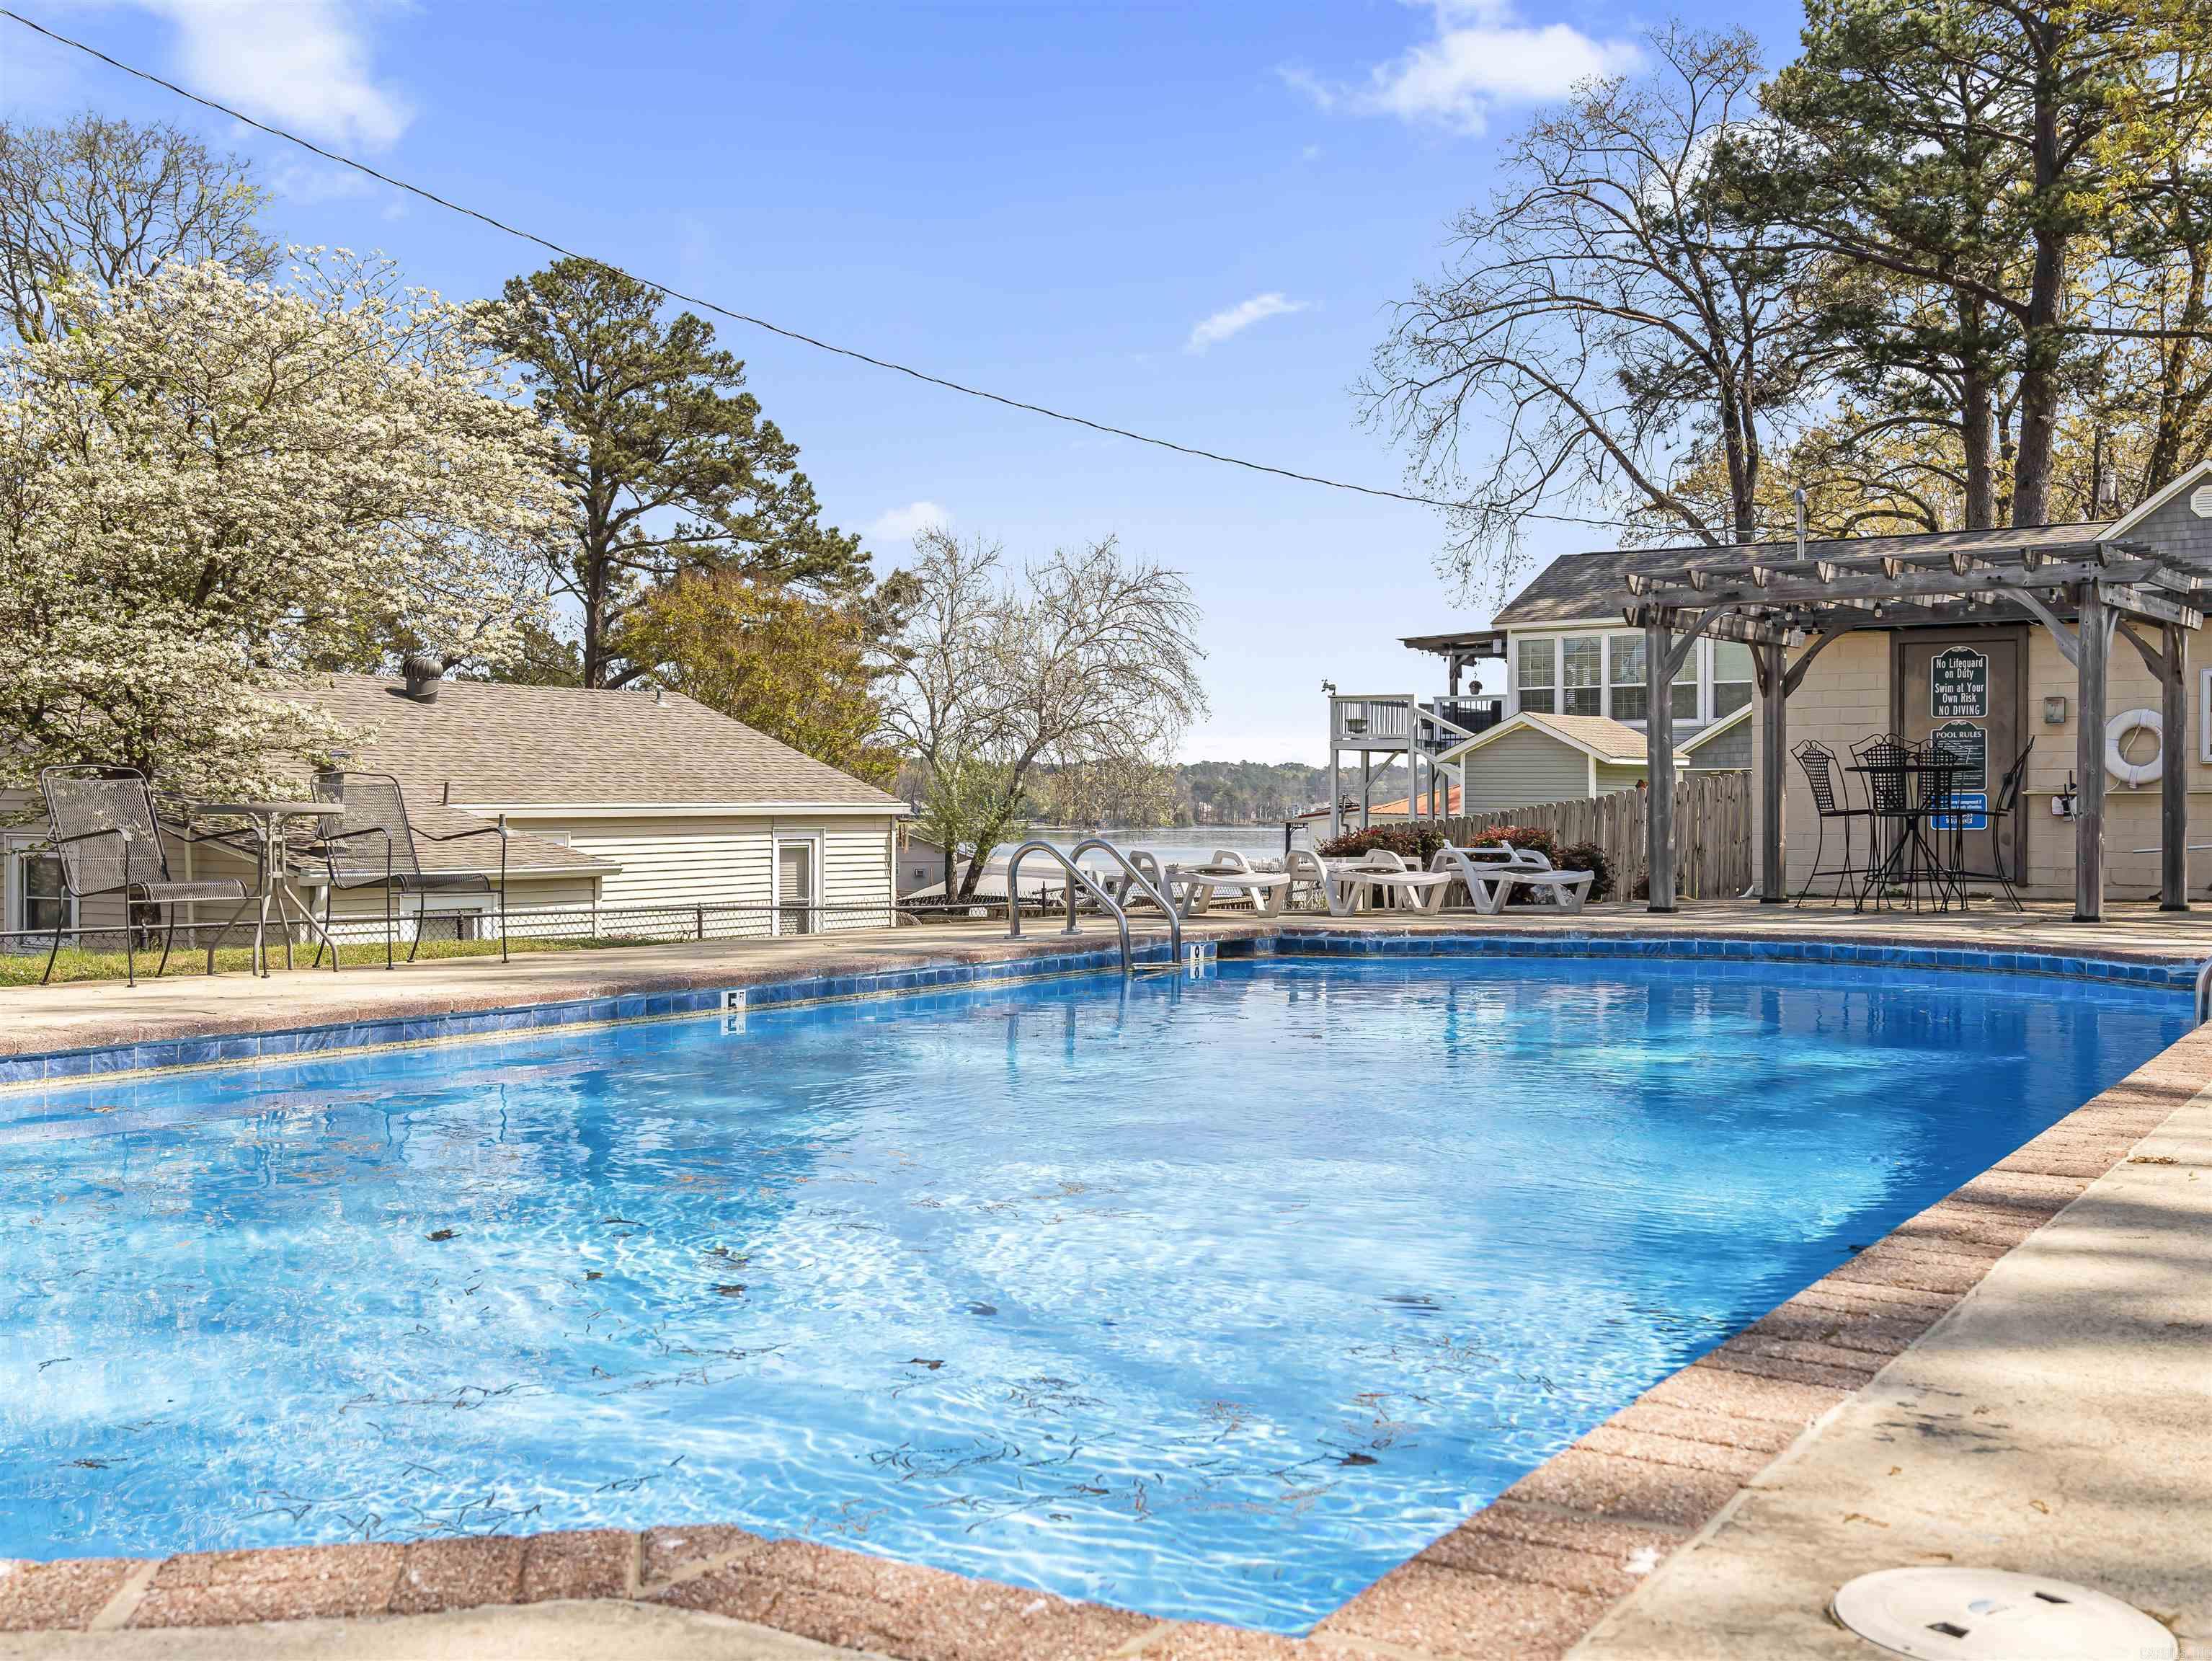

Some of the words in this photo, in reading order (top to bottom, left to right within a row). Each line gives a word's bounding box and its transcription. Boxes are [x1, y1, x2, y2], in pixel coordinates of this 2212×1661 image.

[1936, 658, 1946, 668] No
[1949, 657, 1983, 670] Lifeguard
[1957, 668, 1974, 680] Duty
[1935, 683, 1954, 694] Swim
[1957, 683, 1964, 692] at
[1966, 682, 1984, 692] Your
[1942, 693, 1958, 703] Own
[1960, 693, 1976, 703] Risk
[1939, 705, 1950, 715] NO
[1953, 705, 1980, 715] DIVING
[728, 993, 737, 1009] 5
[739, 992, 745, 1001] FT
